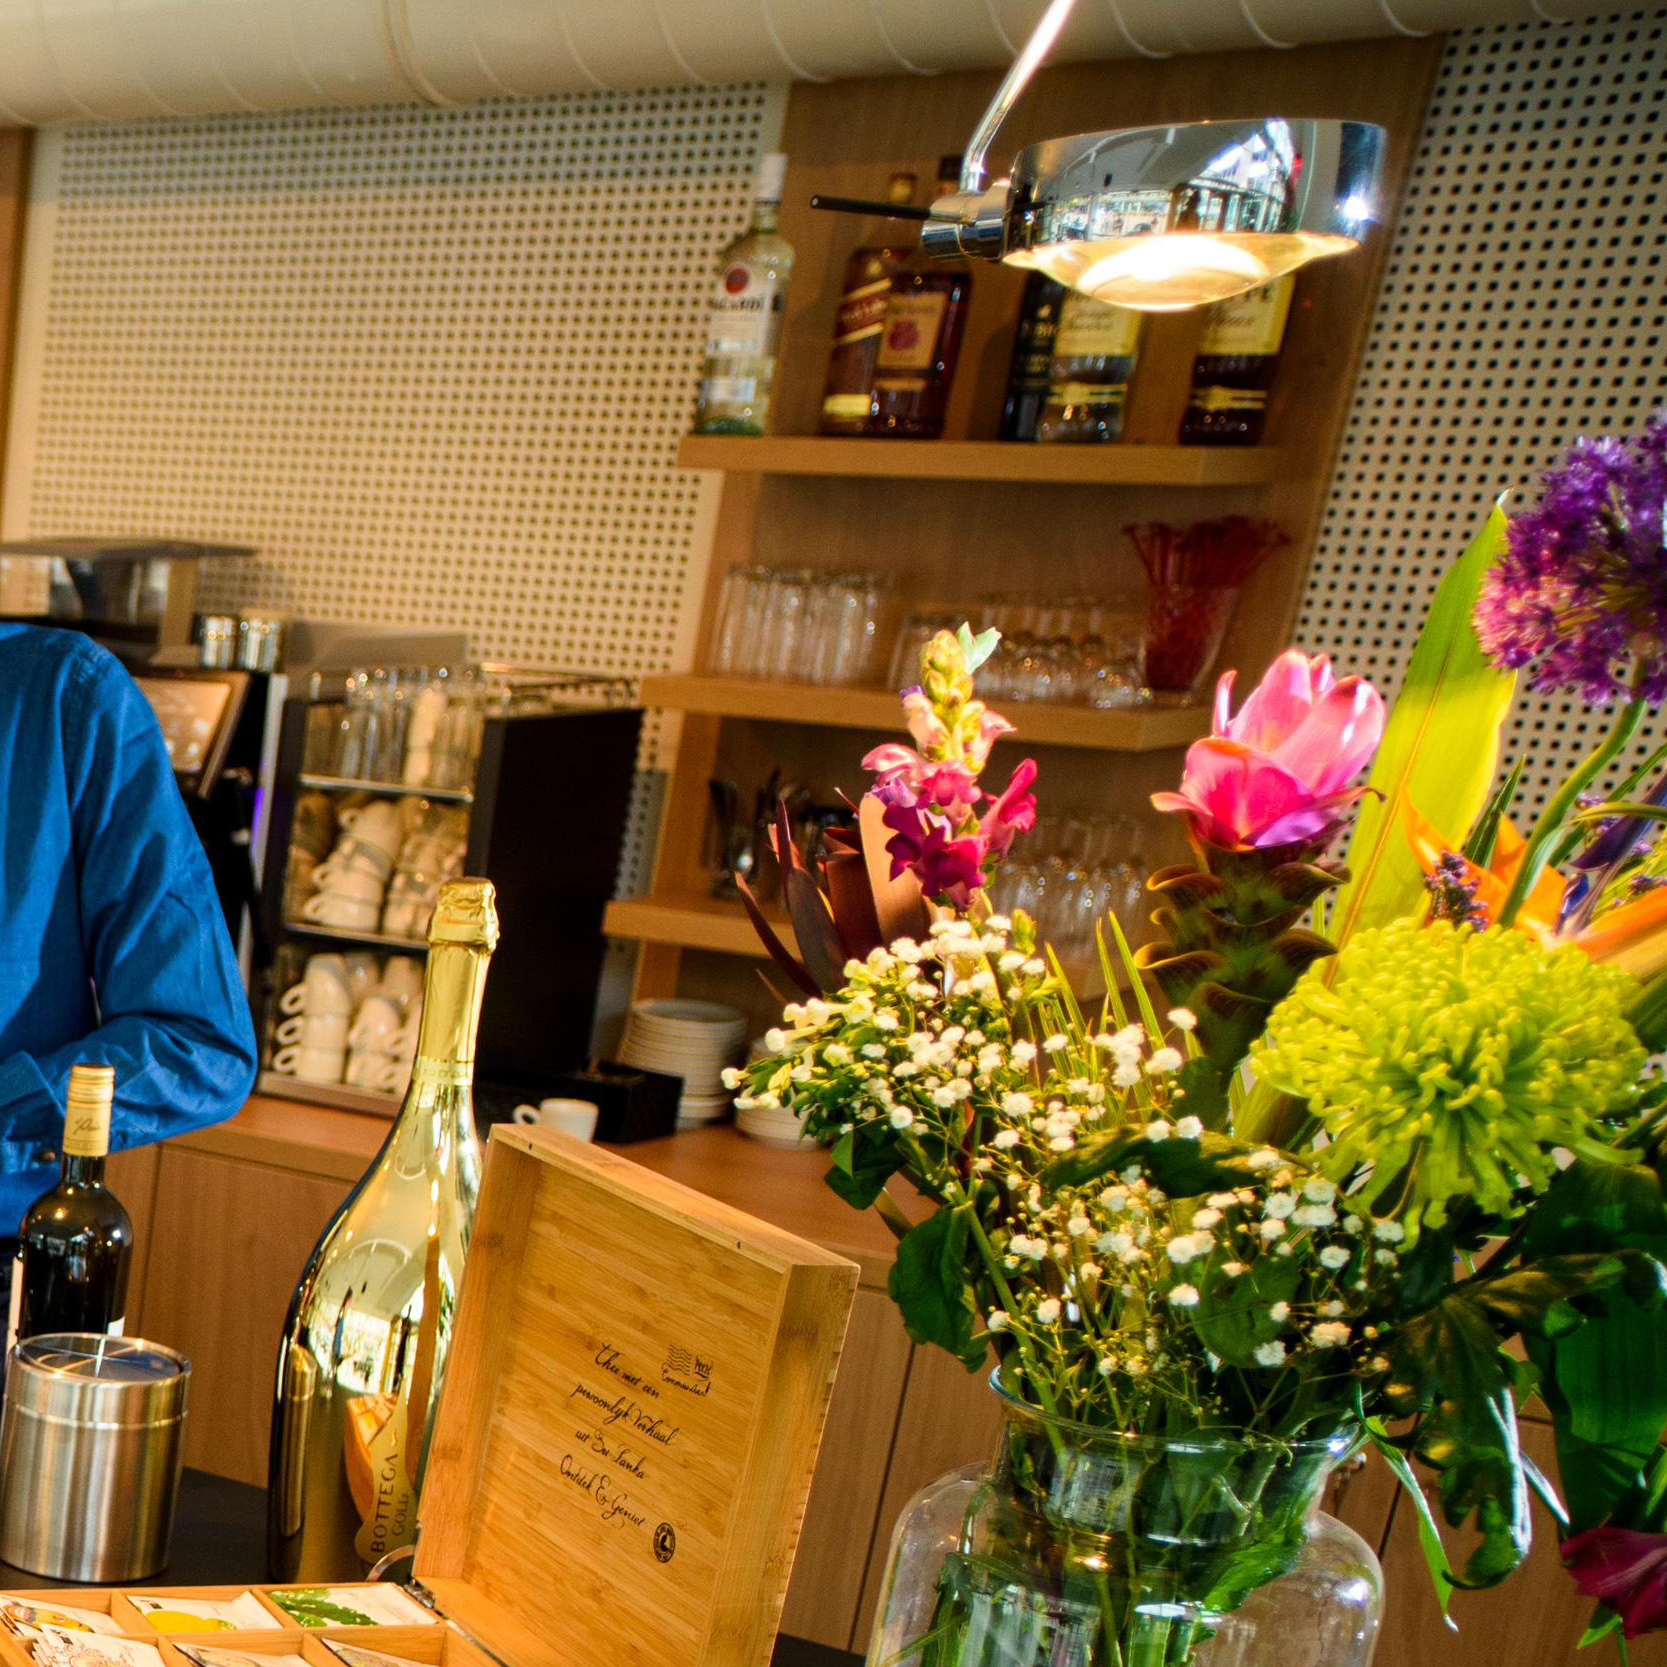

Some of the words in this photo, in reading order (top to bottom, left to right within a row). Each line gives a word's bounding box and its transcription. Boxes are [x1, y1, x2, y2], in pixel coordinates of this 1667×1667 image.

[621, 1371, 643, 1386] met
[642, 1385, 660, 1399] een
[612, 1443, 646, 1479] Lanka
[371, 1453, 398, 1553] BOTTEGA
[560, 1454, 599, 1496] Ontdek
[601, 1493, 646, 1530] Geniet
